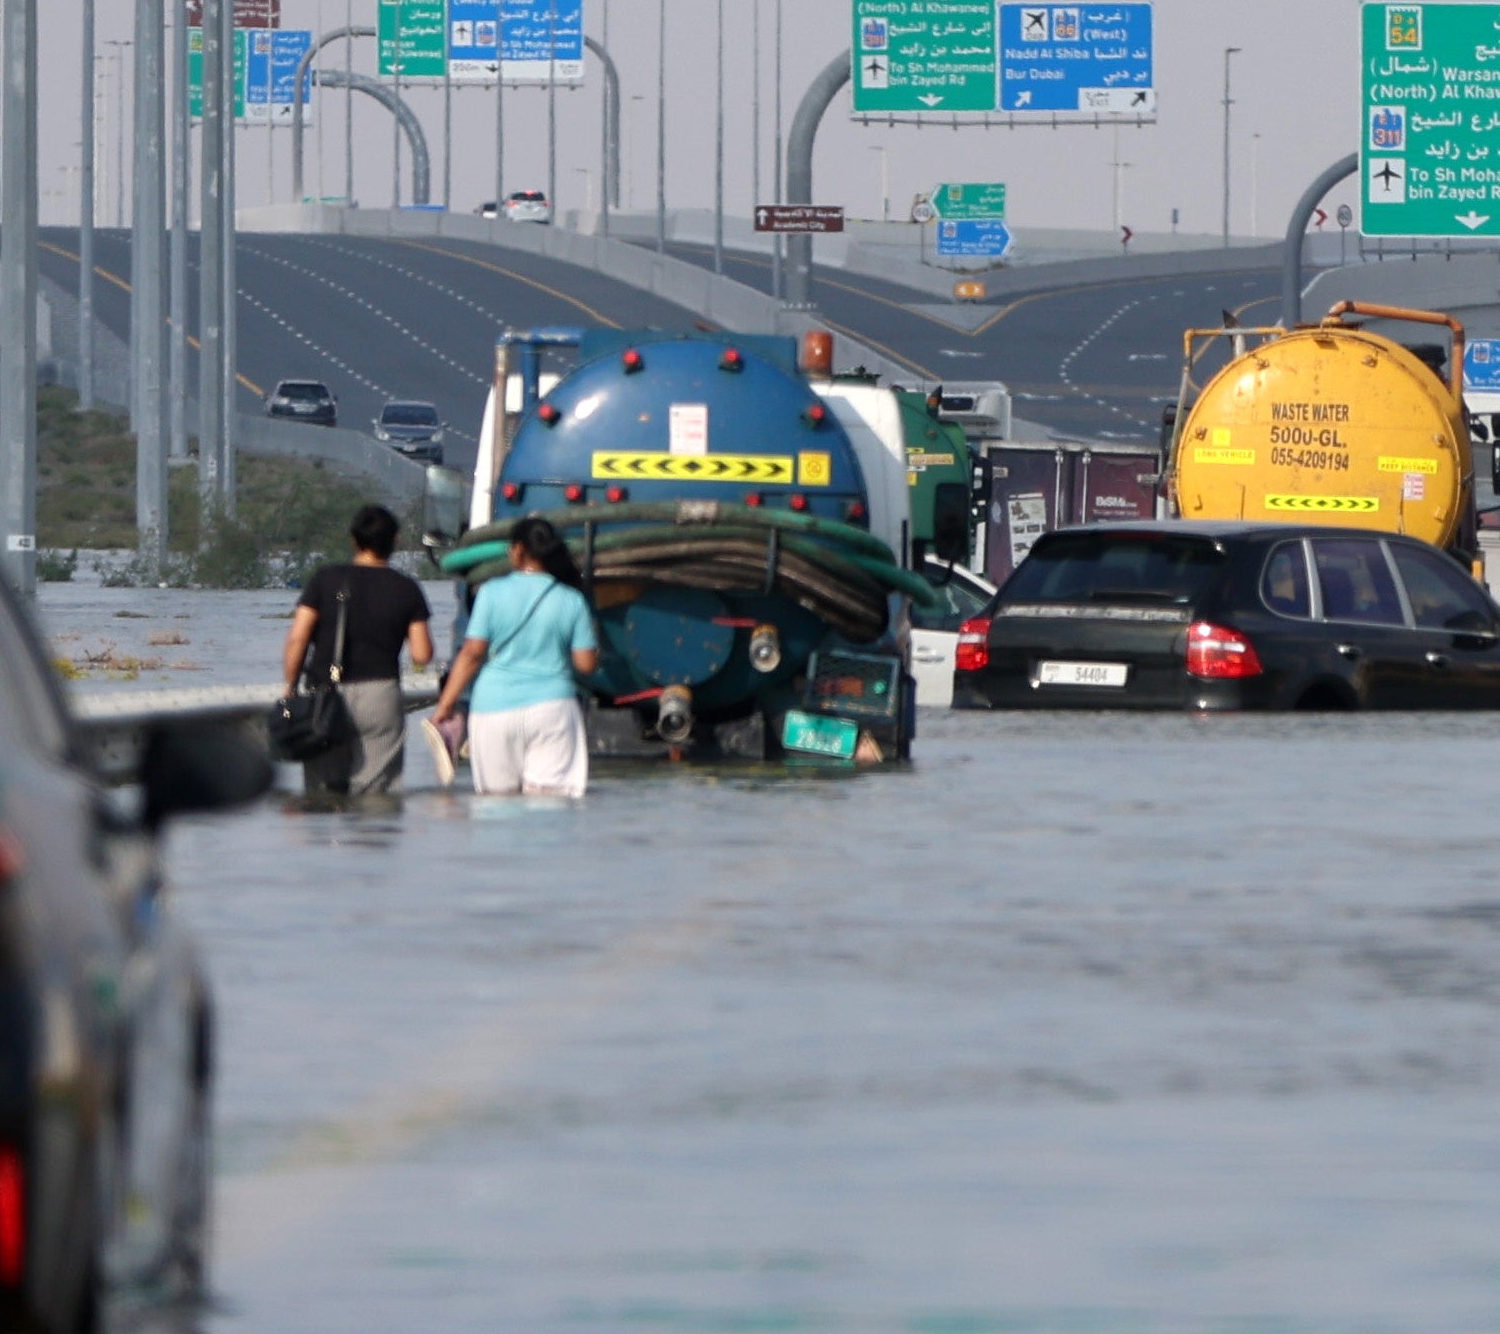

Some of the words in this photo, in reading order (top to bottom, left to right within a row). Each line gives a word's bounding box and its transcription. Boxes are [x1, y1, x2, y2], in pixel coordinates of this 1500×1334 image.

[1391, 27, 1417, 44] 54
[1370, 84, 1437, 102] (North)
[1442, 84, 1460, 99] Al
[1411, 112, 1462, 132] الشيخ
[1375, 129, 1402, 145] 311
[1425, 140, 1461, 160] زايد
[1466, 143, 1489, 160] بن
[1410, 167, 1430, 182] To
[1435, 167, 1455, 182] Sh
[1409, 185, 1433, 199] bin
[1438, 185, 1486, 202] Zayed
[1271, 403, 1309, 422] WASTE
[1312, 403, 1349, 423] WATER
[1220, 450, 1253, 459] VEHICLE
[1271, 447, 1349, 471] 055-4209194
